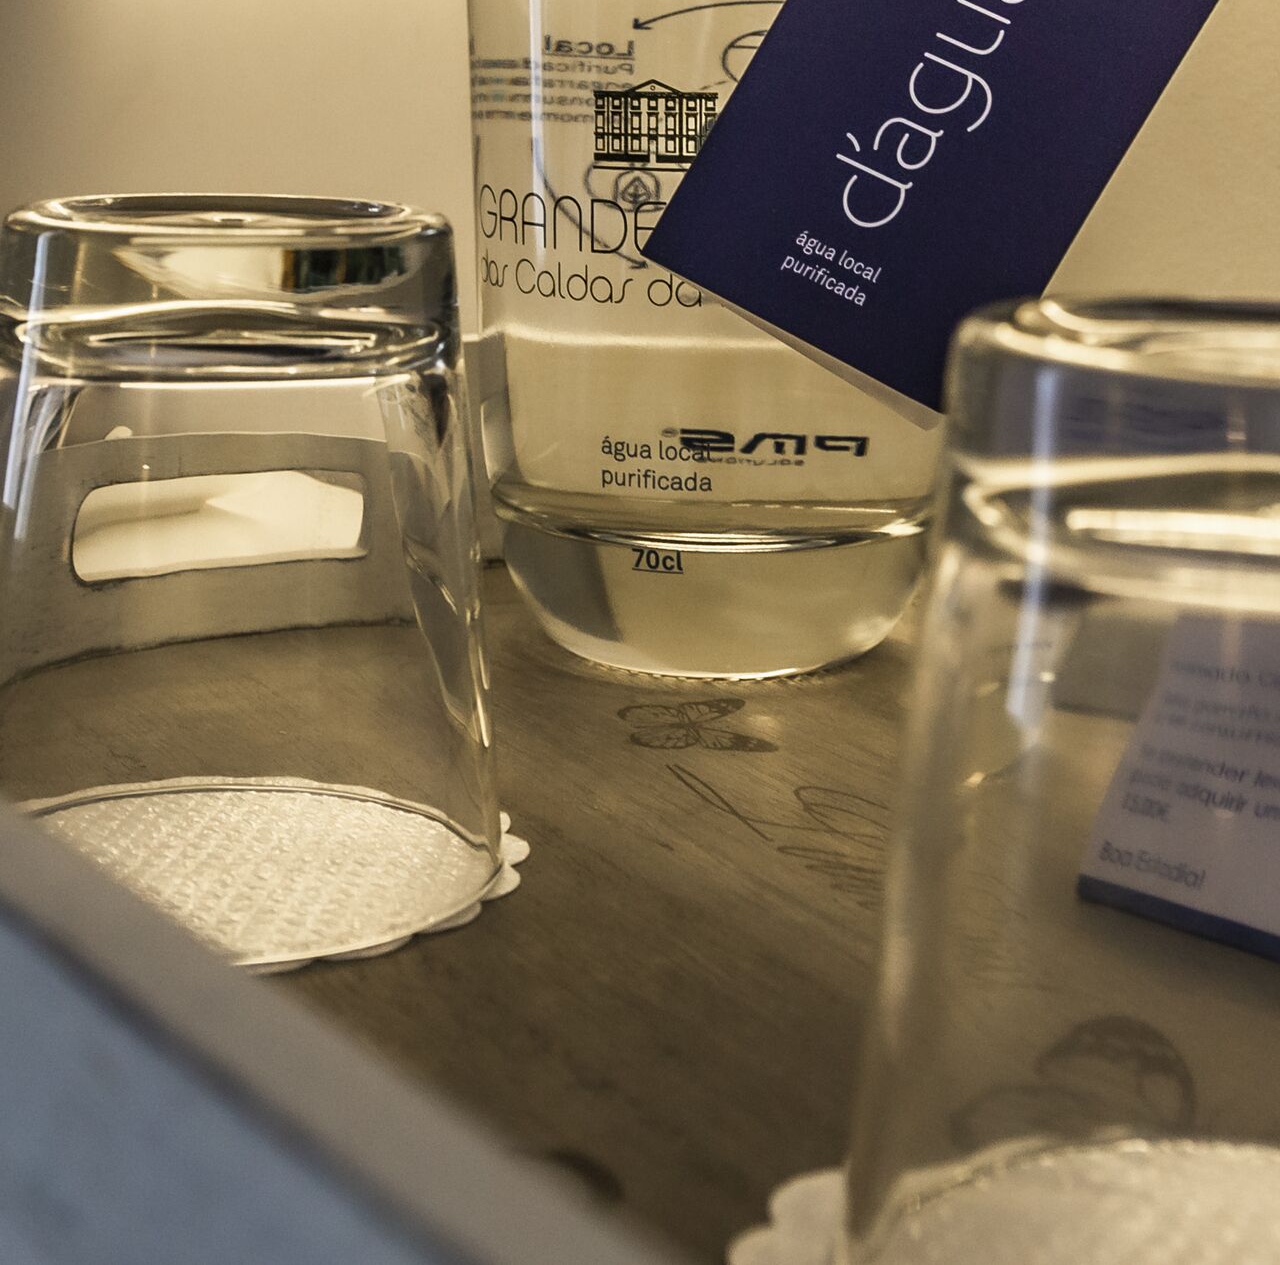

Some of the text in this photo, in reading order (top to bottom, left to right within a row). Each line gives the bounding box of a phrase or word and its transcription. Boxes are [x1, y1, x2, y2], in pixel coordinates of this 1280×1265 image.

[480, 184, 667, 254] GRANDE
[481, 247, 508, 288] das
[515, 258, 634, 304] Caldas
[780, 255, 867, 307] purificada
[795, 230, 882, 283] água local
[601, 435, 713, 462] água local
[601, 468, 713, 492] purificada
[632, 548, 684, 572] 70cl
